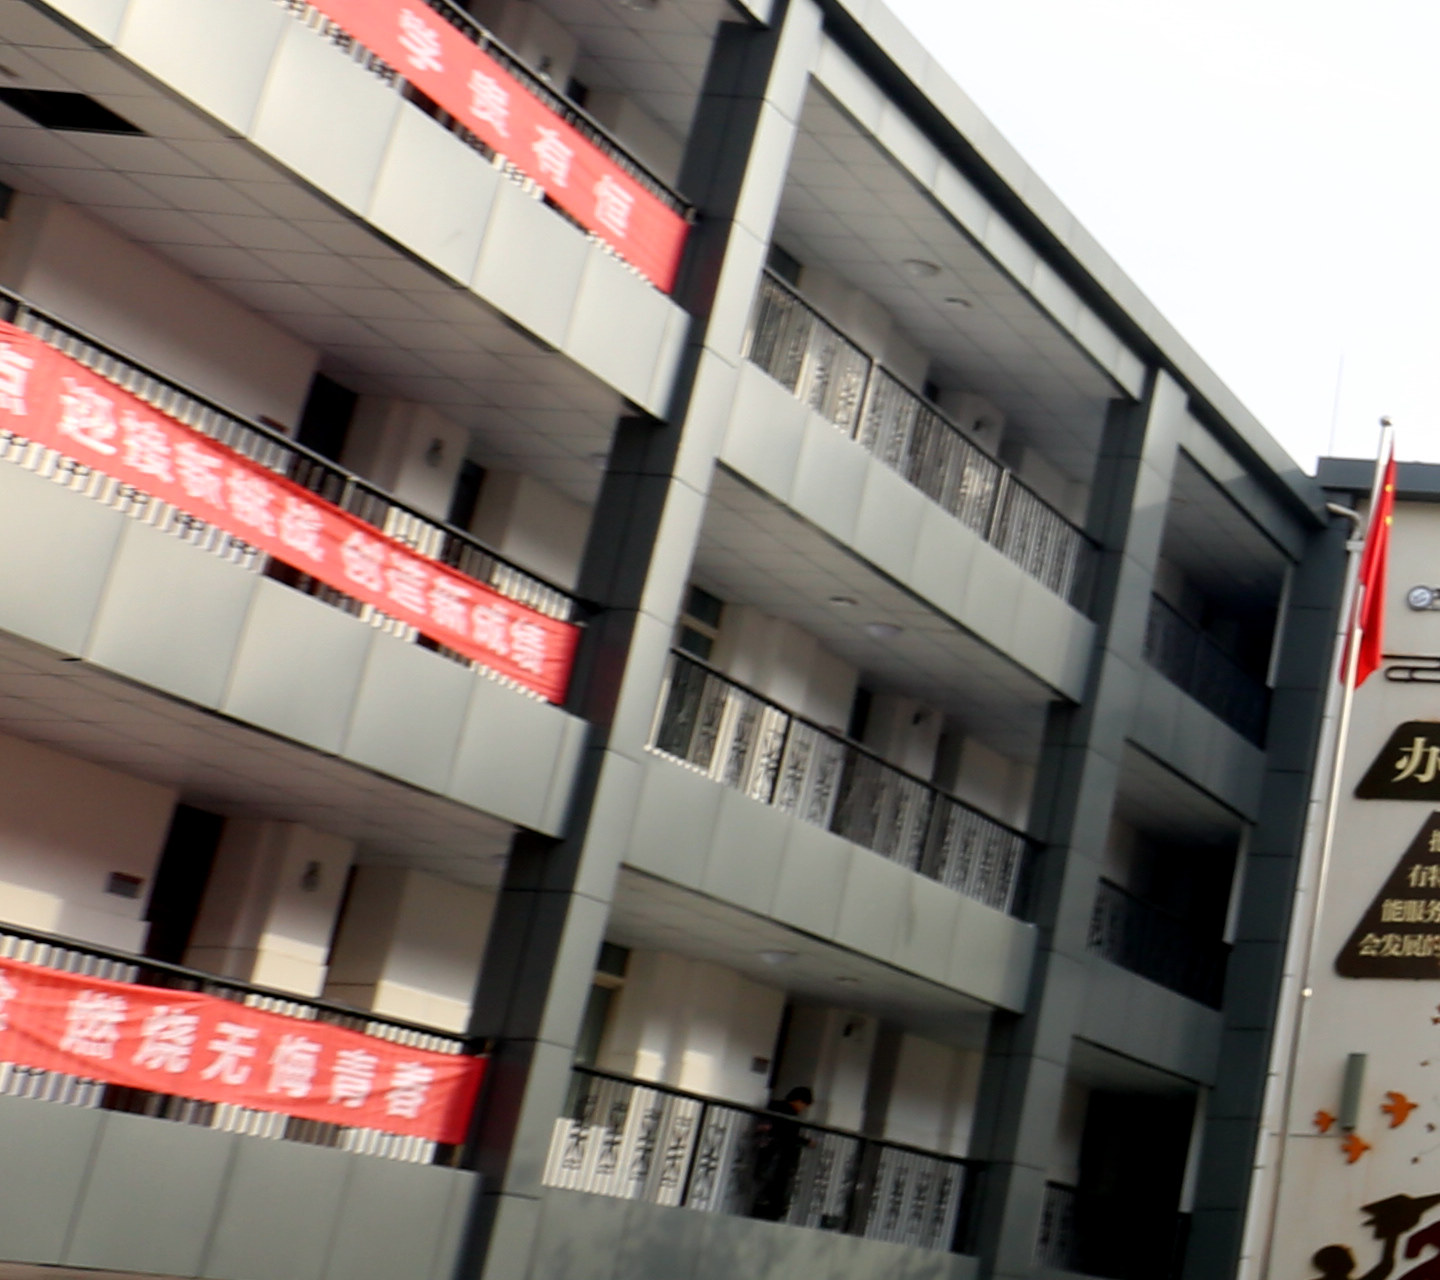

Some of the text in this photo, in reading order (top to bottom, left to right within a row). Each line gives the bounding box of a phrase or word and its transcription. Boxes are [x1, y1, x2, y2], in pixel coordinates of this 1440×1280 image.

[58, 988, 435, 1120] 燃烧无悔青春
